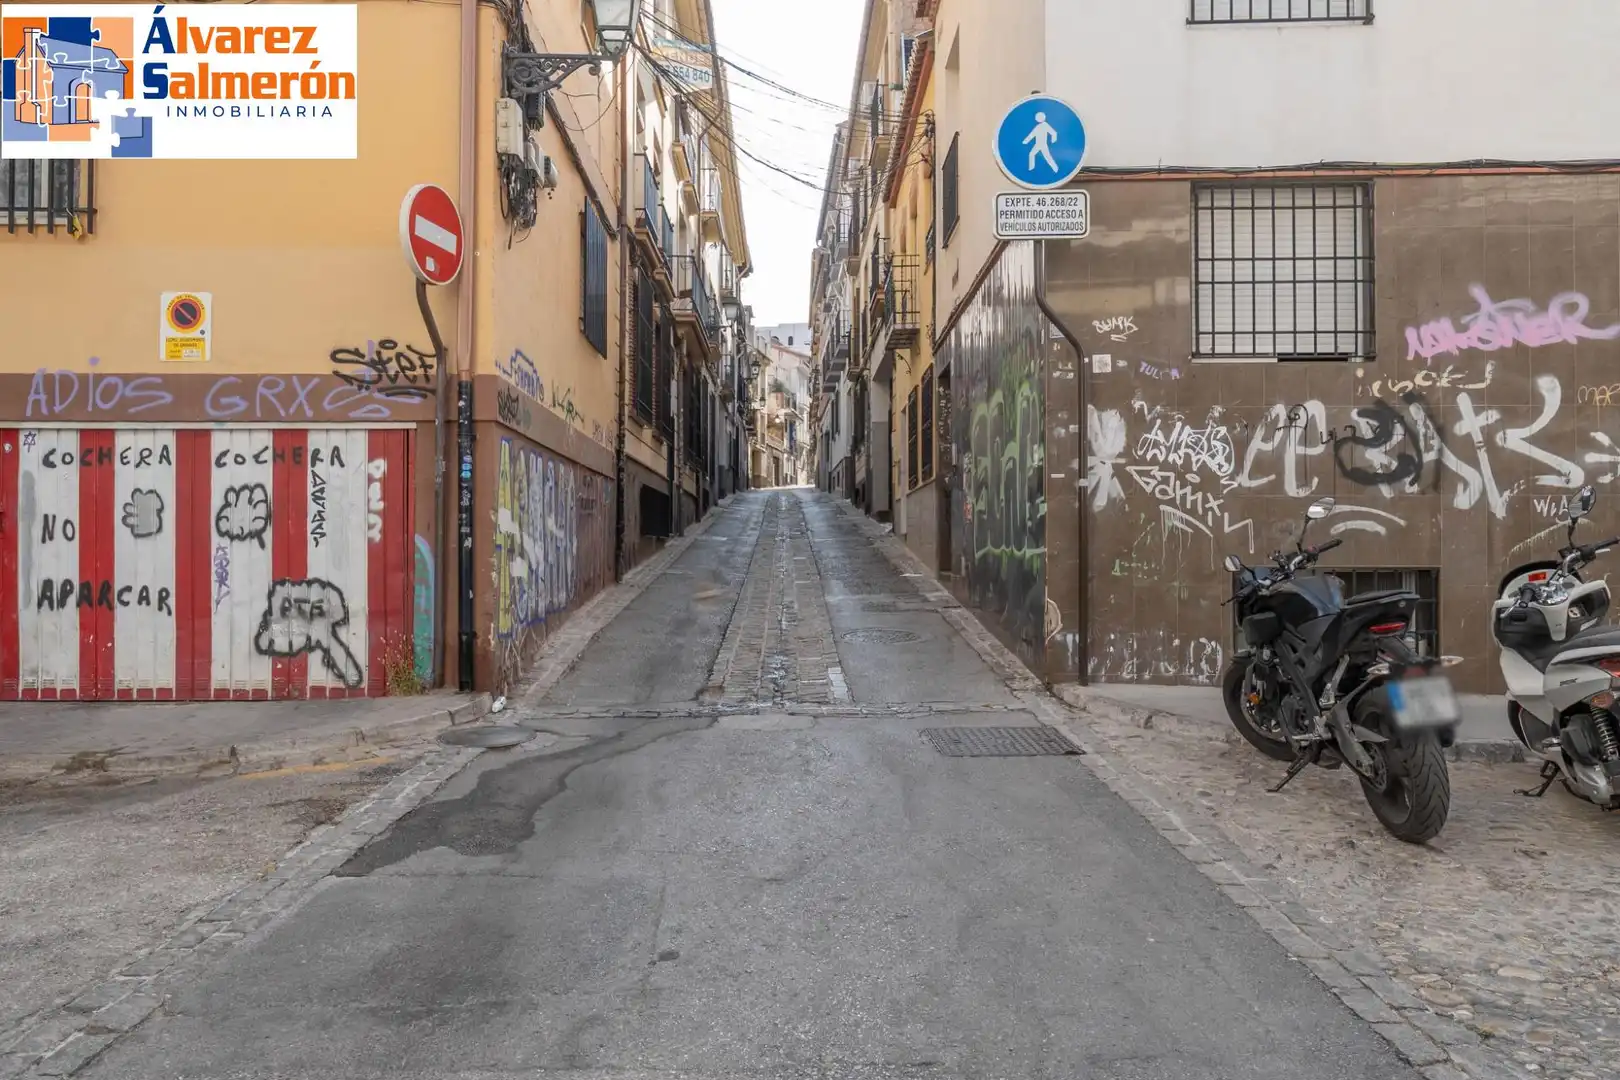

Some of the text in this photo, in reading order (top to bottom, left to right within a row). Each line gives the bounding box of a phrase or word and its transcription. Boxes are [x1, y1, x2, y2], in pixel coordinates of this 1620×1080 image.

[1000, 209, 1084, 219] PERMITIDO ACCESO A
[1005, 197, 1078, 207] EXPTE. 46.268/22
[1037, 221, 1084, 231] AUTORIZADOS
[204, 376, 320, 417] GRX
[42, 444, 345, 468] COCHERA COCHERA
[41, 514, 75, 544] NO
[37, 578, 172, 617] APARCAR
